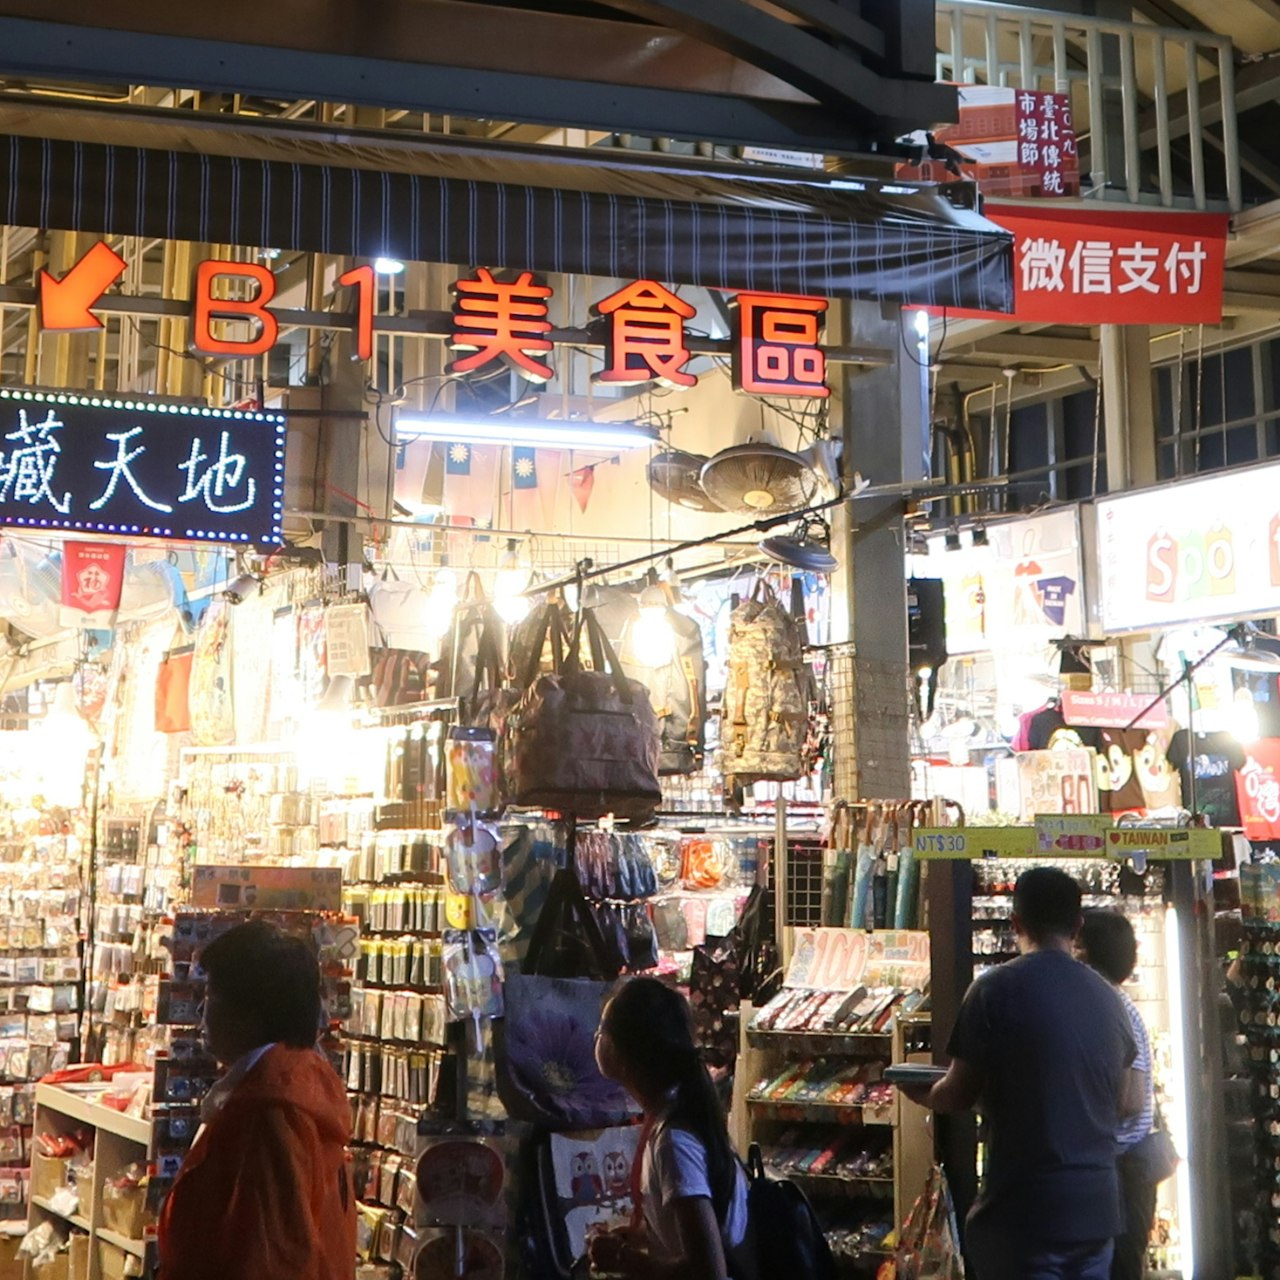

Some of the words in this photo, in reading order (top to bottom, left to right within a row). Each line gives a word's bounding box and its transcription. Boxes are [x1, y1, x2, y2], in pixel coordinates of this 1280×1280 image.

[1018, 92, 1040, 167] 市場節
[1040, 93, 1065, 196] 臺北傳統
[1019, 237, 1208, 296] 微信支付
[192, 259, 831, 400] B1美食區
[915, 834, 965, 853] NT$30
[1121, 832, 1169, 846] TAIWAN
[808, 931, 866, 986] 100
